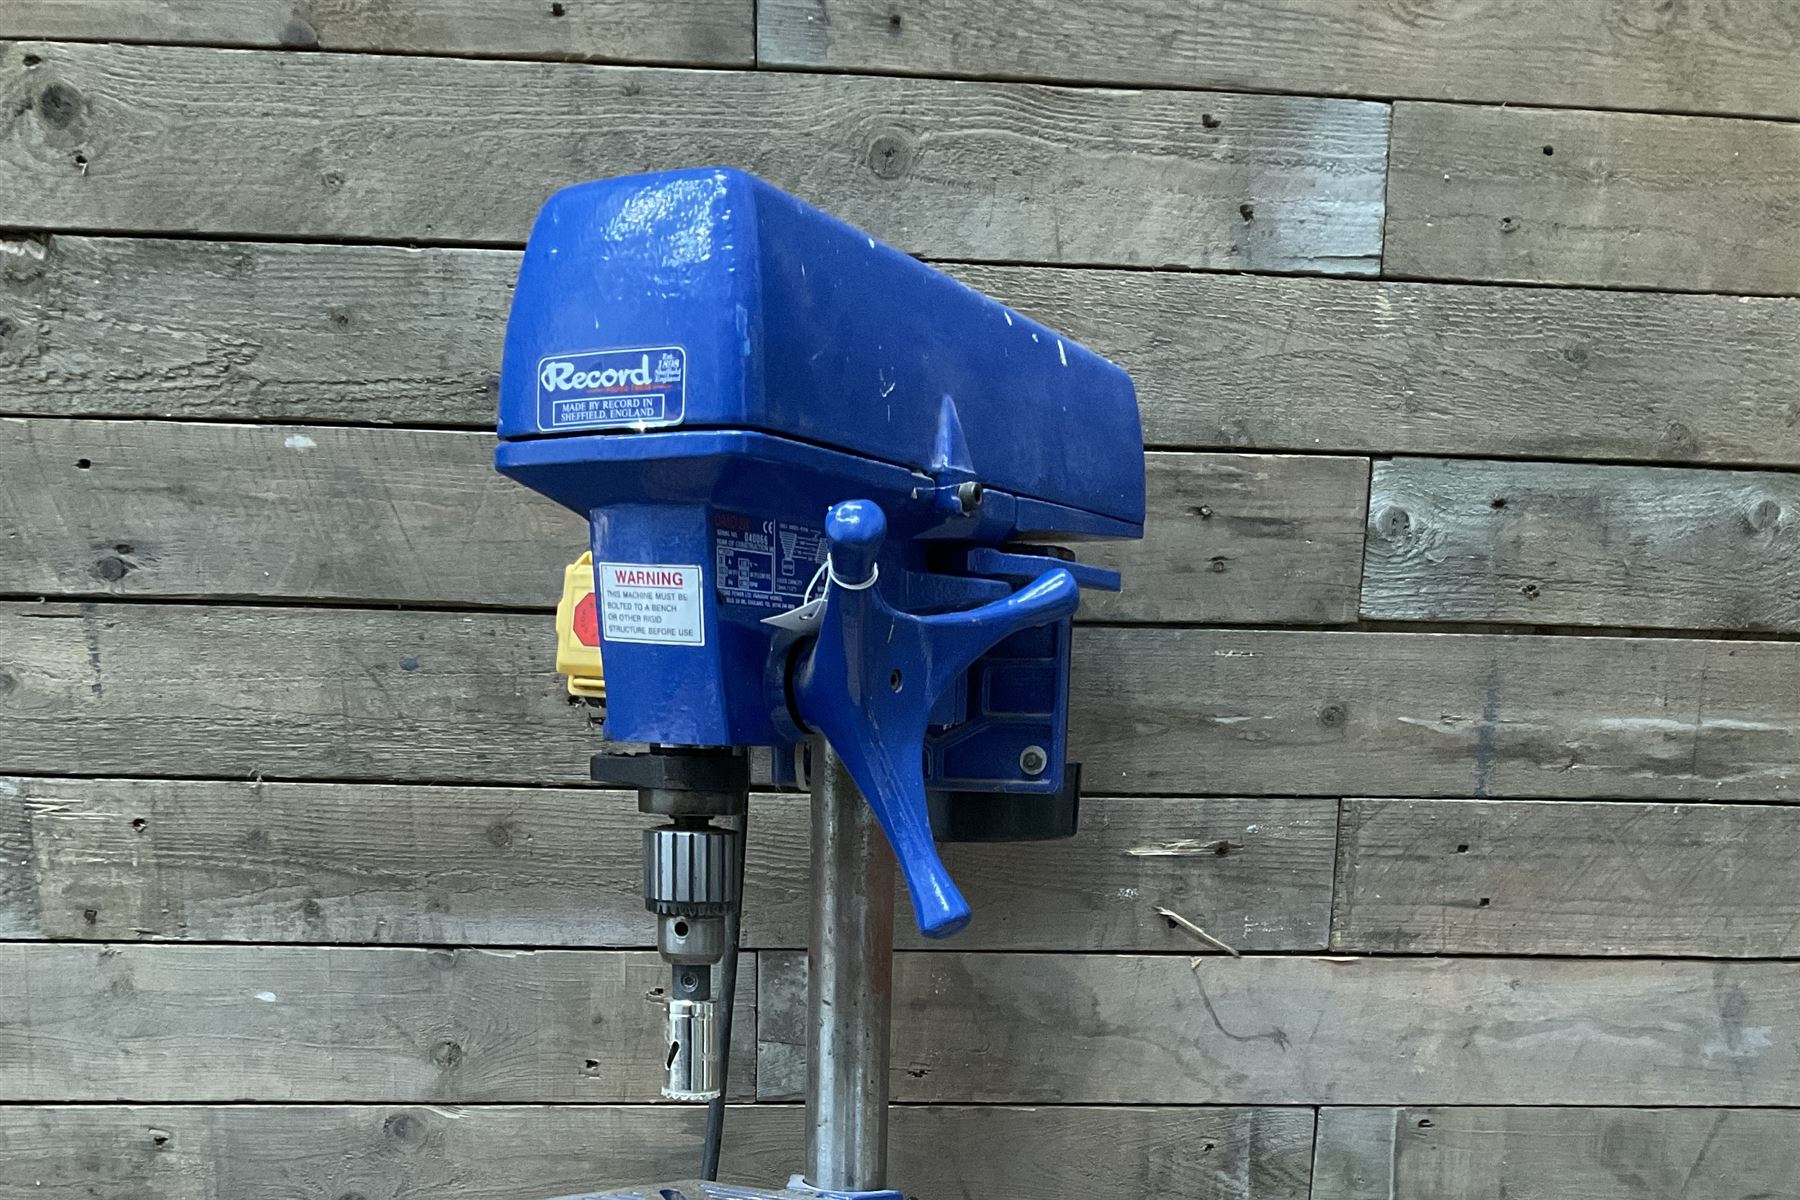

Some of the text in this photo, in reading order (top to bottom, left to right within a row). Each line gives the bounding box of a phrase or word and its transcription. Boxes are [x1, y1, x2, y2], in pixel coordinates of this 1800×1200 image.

[541, 354, 652, 392] Record
[562, 398, 653, 413] MADE BY RECORD IN
[610, 407, 654, 419] ENGLAND
[614, 570, 683, 586] WARNING
[607, 590, 689, 601] THIS MACHINE MUST BE
[607, 602, 677, 612] BOLTED TO A BENCH
[619, 614, 641, 622] OTHER
[643, 615, 662, 624] RIGID
[608, 625, 694, 637] STRUCTURE BEFORE USE
